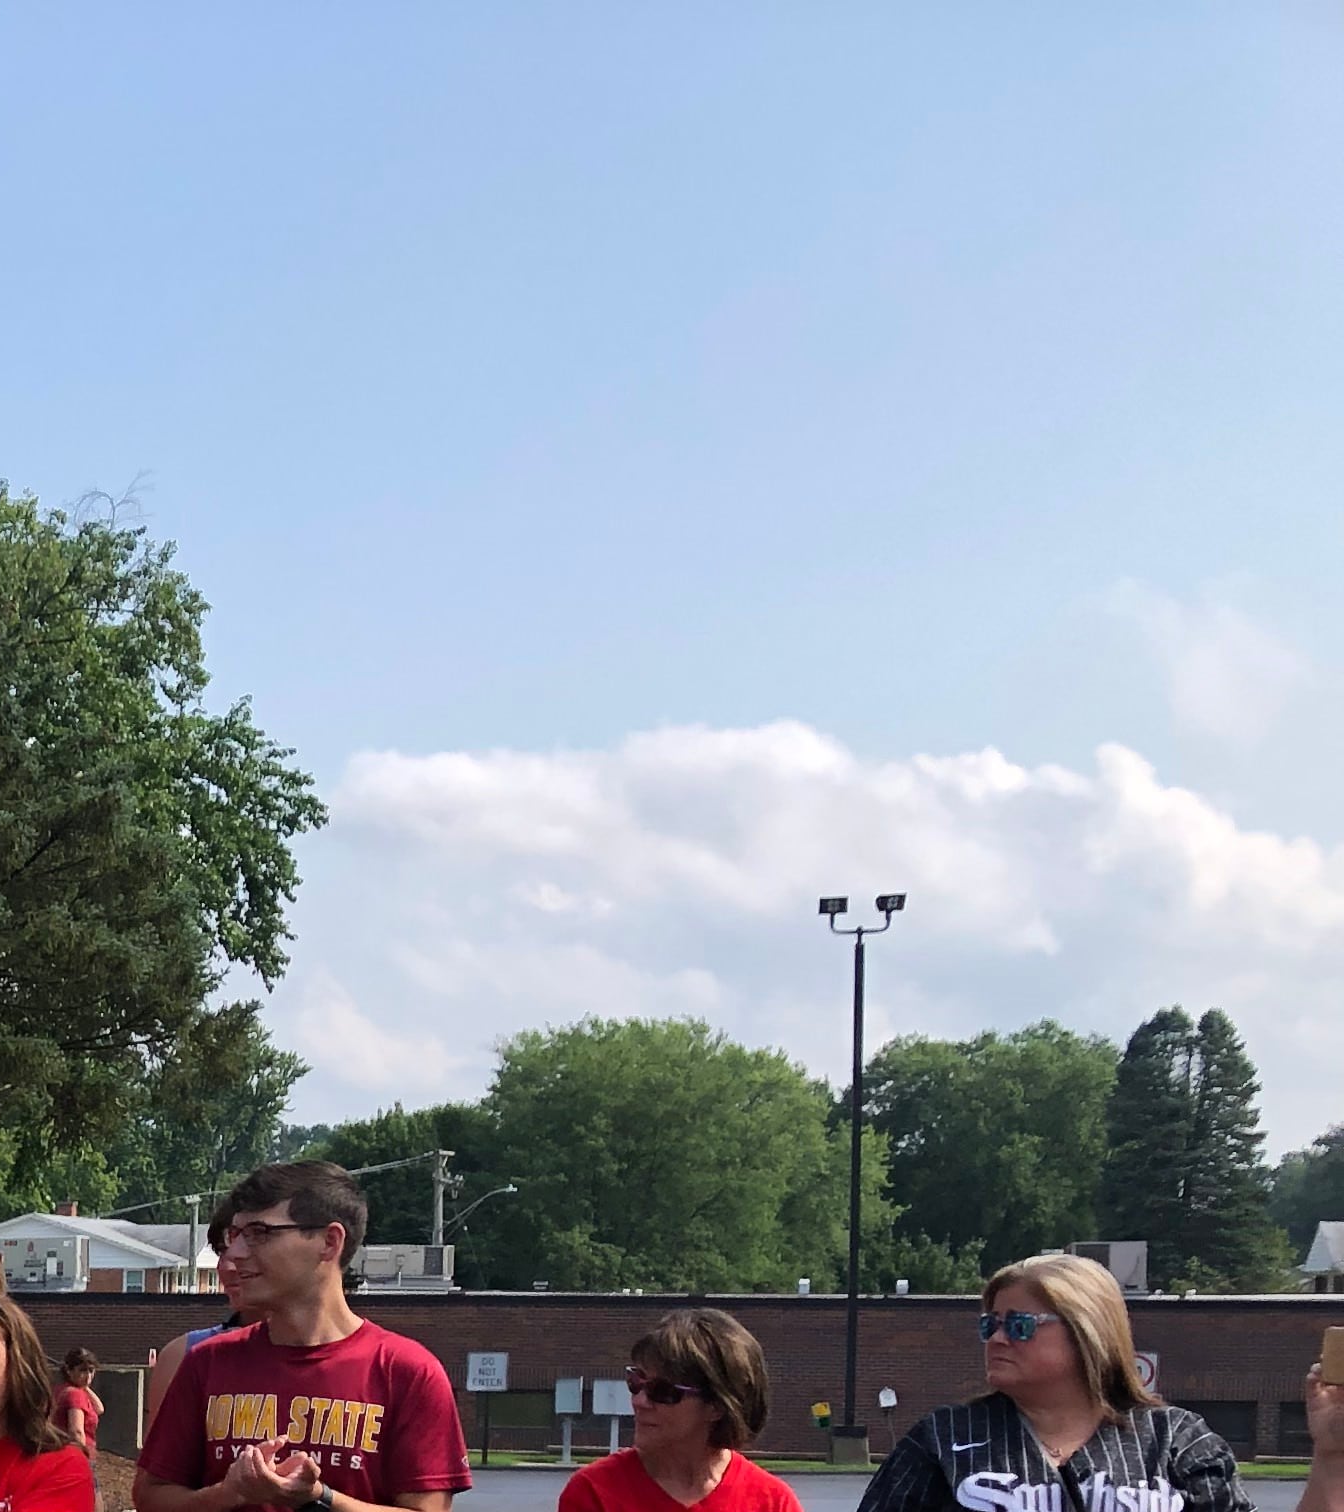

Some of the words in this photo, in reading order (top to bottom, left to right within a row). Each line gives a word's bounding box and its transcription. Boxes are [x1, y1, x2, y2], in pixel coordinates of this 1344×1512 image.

[481, 1357, 495, 1366] DO
[478, 1367, 496, 1377] NOT
[472, 1377, 502, 1387] ENTER
[206, 1394, 278, 1442] IOWA
[287, 1396, 385, 1453] STATE
[215, 1445, 363, 1470] CYNES
